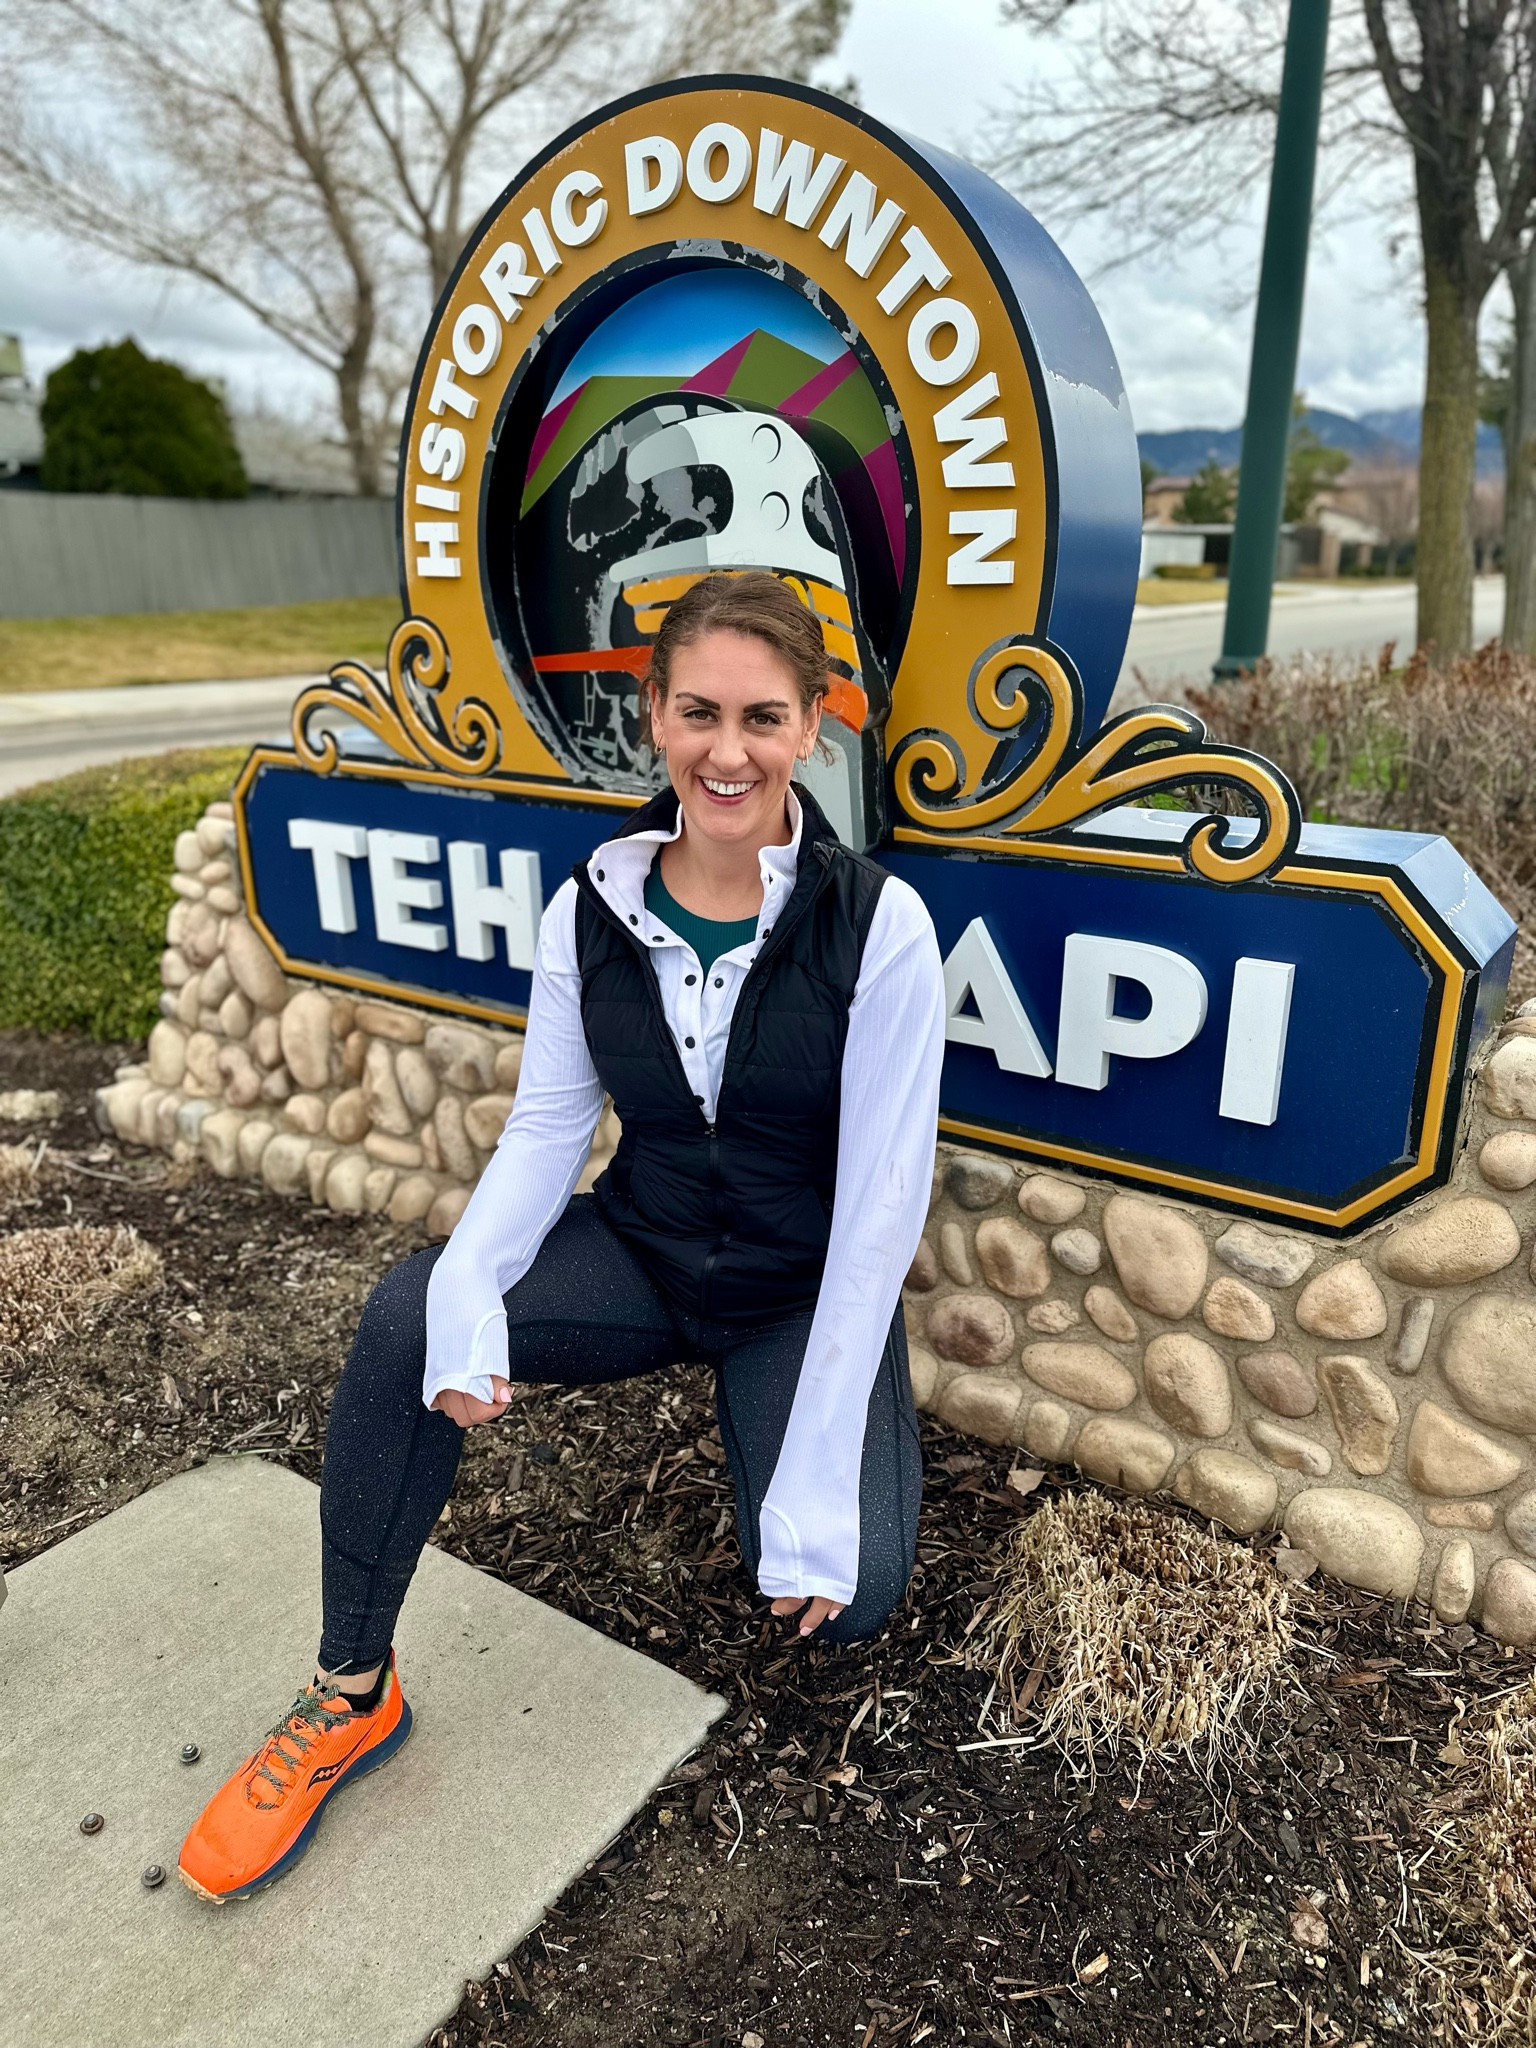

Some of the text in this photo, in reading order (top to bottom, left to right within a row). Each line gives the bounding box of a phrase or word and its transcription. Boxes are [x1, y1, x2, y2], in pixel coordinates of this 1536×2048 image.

[415, 122, 1016, 586] HISTORIC DOWNTOWN
[287, 818, 1296, 1126] TEHAPI
